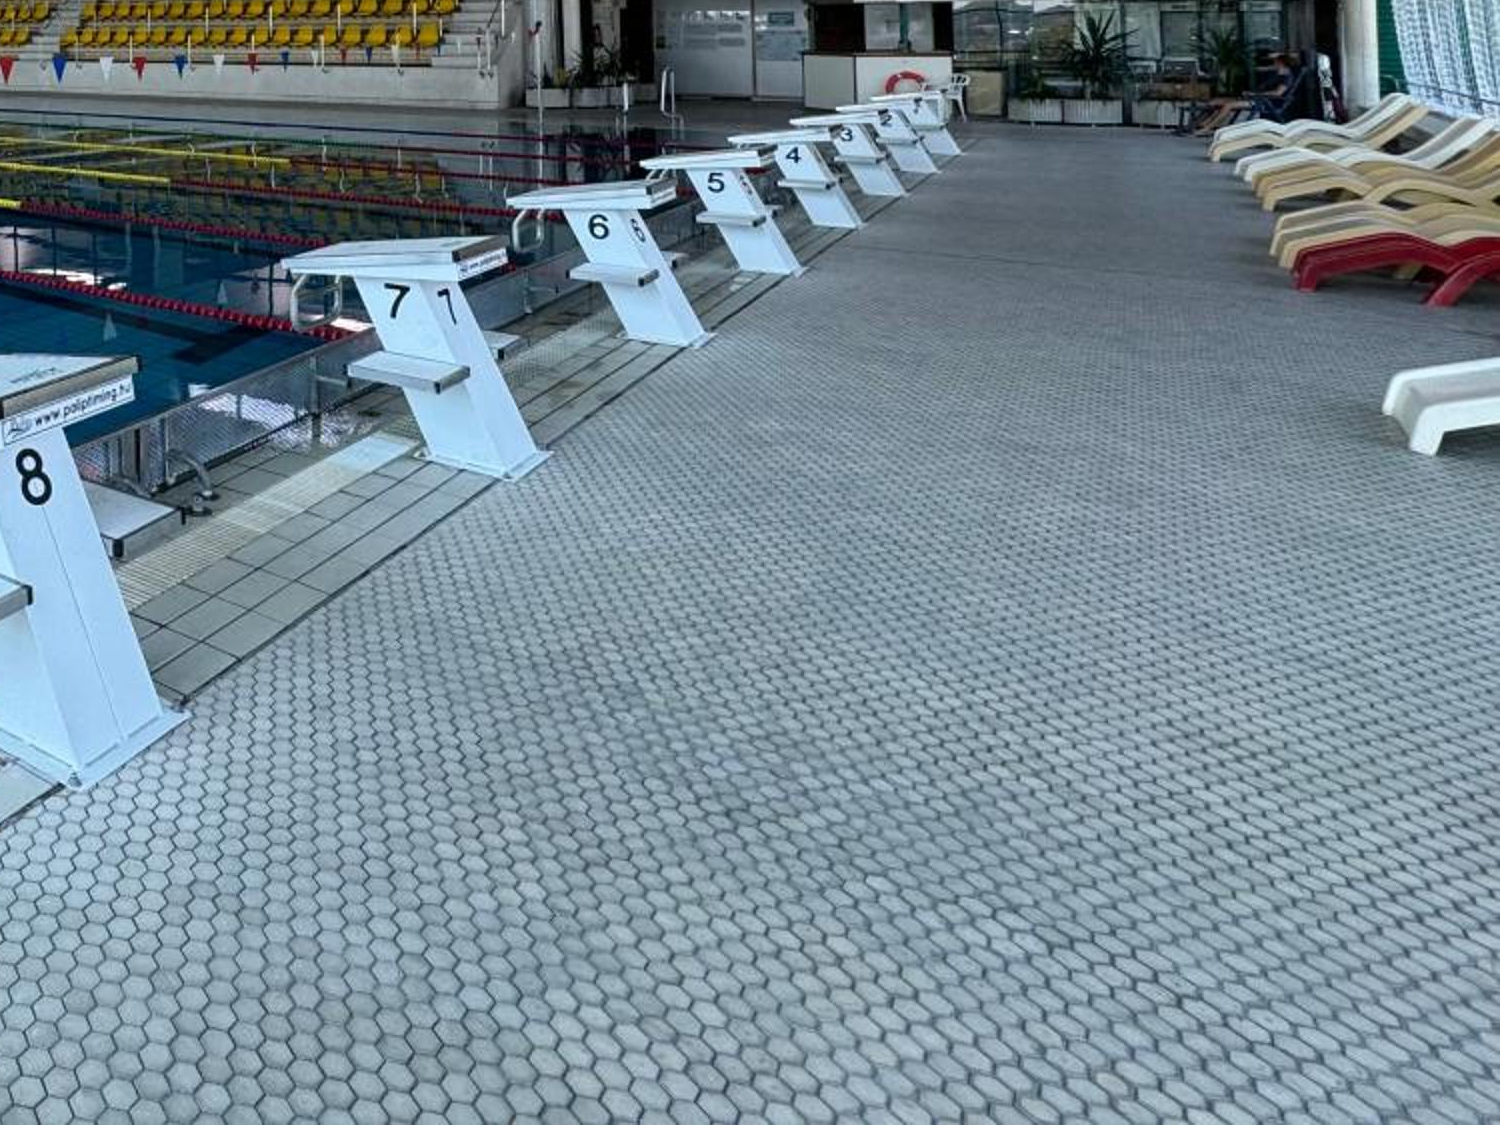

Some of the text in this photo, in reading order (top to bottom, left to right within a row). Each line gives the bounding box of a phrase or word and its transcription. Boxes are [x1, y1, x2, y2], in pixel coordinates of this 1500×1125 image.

[841, 127, 854, 142] 3
[786, 147, 802, 163] 4
[707, 173, 725, 193] 5
[588, 214, 610, 240] 6
[384, 283, 411, 319] 7
[437, 288, 457, 326] 7
[16, 448, 53, 506] 8
